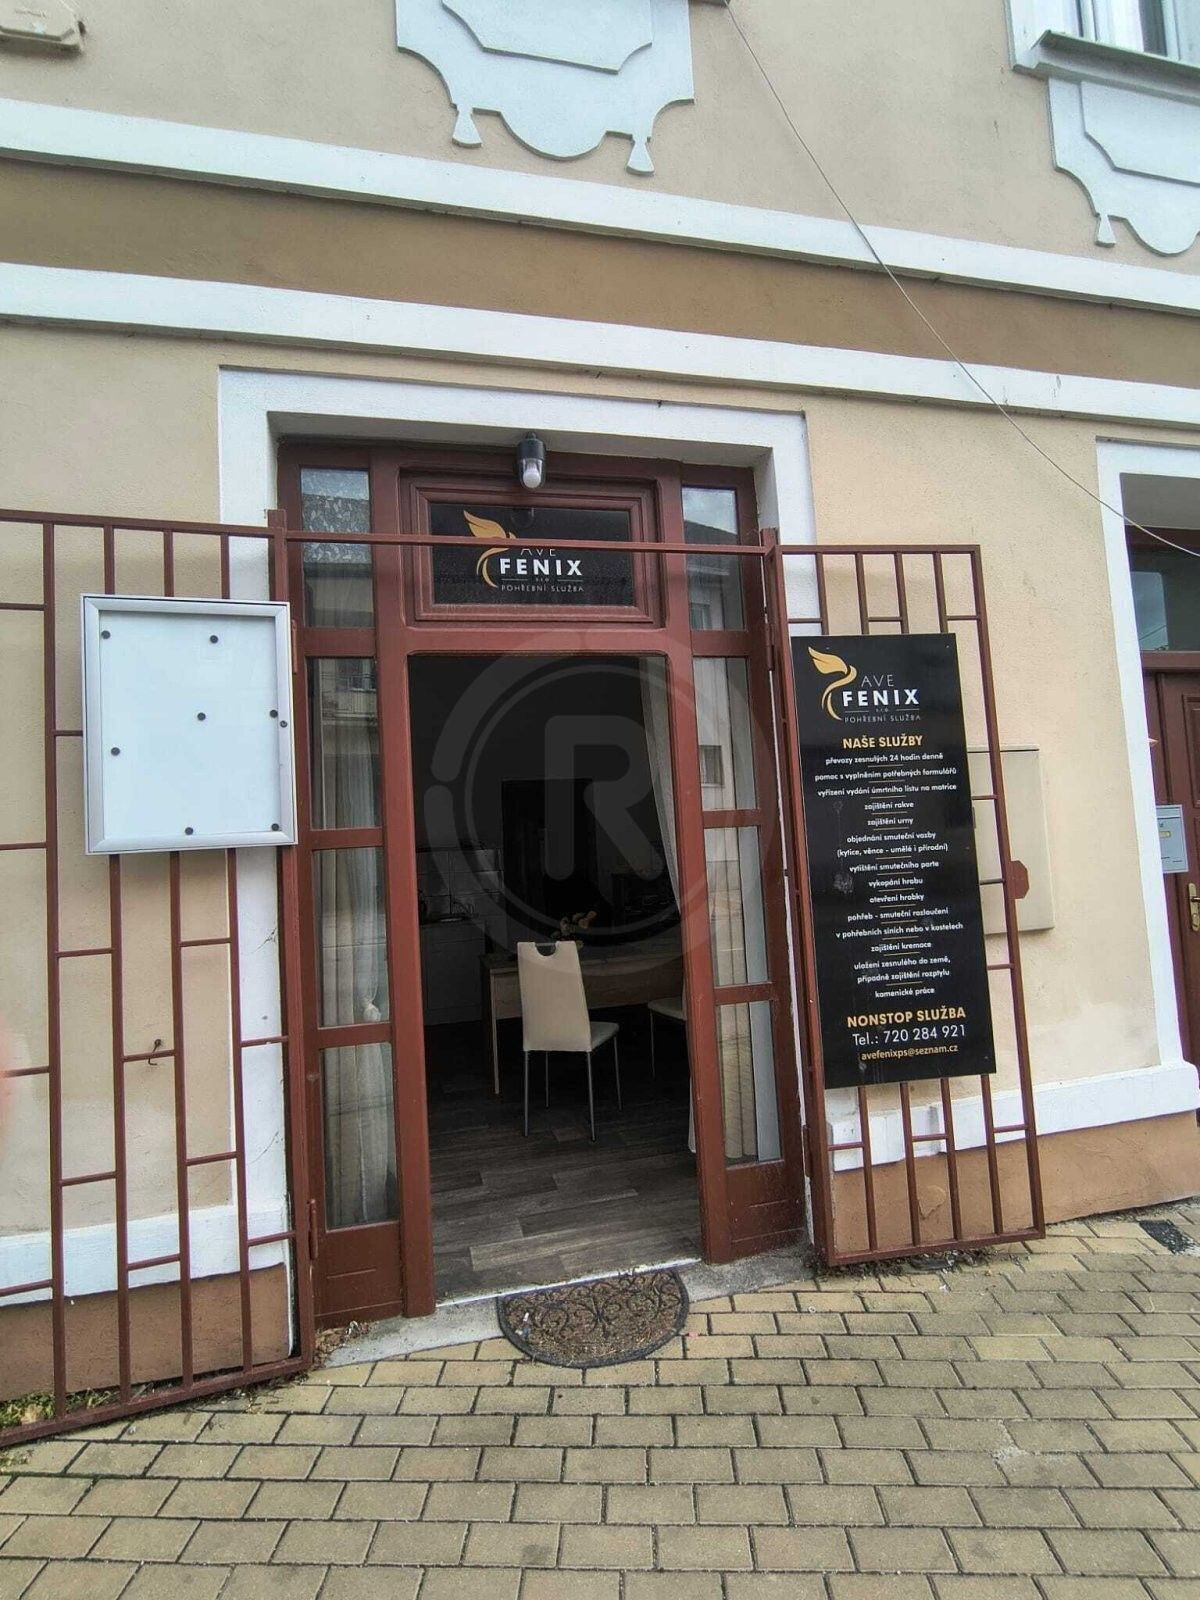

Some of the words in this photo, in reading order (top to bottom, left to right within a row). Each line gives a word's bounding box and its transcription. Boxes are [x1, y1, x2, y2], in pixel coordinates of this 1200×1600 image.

[500, 559, 583, 575] FENIX
[502, 583, 546, 592] POHŘEBNÍ
[861, 674, 894, 687] AVE
[842, 689, 919, 707] FENIX
[844, 714, 886, 723] POHŘEBNÍ
[890, 713, 921, 722] SLUŽBA
[842, 735, 875, 749] NAŠE
[879, 734, 923, 747] SLUŽBY
[826, 757, 852, 765] převozy
[854, 755, 888, 763] zesnulých
[815, 774, 838, 782] pomoc
[883, 769, 921, 778] potřebných
[846, 788, 870, 796] vydání
[905, 784, 918, 792] listu
[864, 802, 893, 811] zajištění
[868, 818, 896, 827] zajištění
[847, 835, 882, 844] objednání
[884, 832, 914, 840] smuteční
[916, 831, 936, 840] vazby
[849, 865, 878, 873] vytištění
[921, 861, 939, 869] parte
[868, 878, 900, 887] vykopání
[870, 895, 898, 903] otevření
[900, 893, 924, 901] hrobky
[848, 913, 873, 922] pohřeb
[880, 908, 911, 918] smuteční
[913, 907, 948, 916] rozloučení
[906, 925, 923, 933] nebo
[931, 922, 963, 930] kostelech
[871, 943, 900, 952] zajištění
[902, 942, 932, 950] kremace
[854, 962, 880, 970] uložení
[882, 958, 917, 967] zesnulého
[891, 971, 920, 980] zajištění
[922, 969, 950, 978] rozptylu
[875, 988, 913, 998] kamenické
[915, 987, 935, 996] práce
[847, 1012, 913, 1028] NONSTOP
[917, 1005, 966, 1022] SLUŽBA
[852, 1032, 878, 1046] Tel.:
[884, 1029, 908, 1044] 720
[913, 1026, 938, 1040] 284
[942, 1024, 965, 1038] 921
[861, 1044, 958, 1060] avefenixps@seznam.cz
